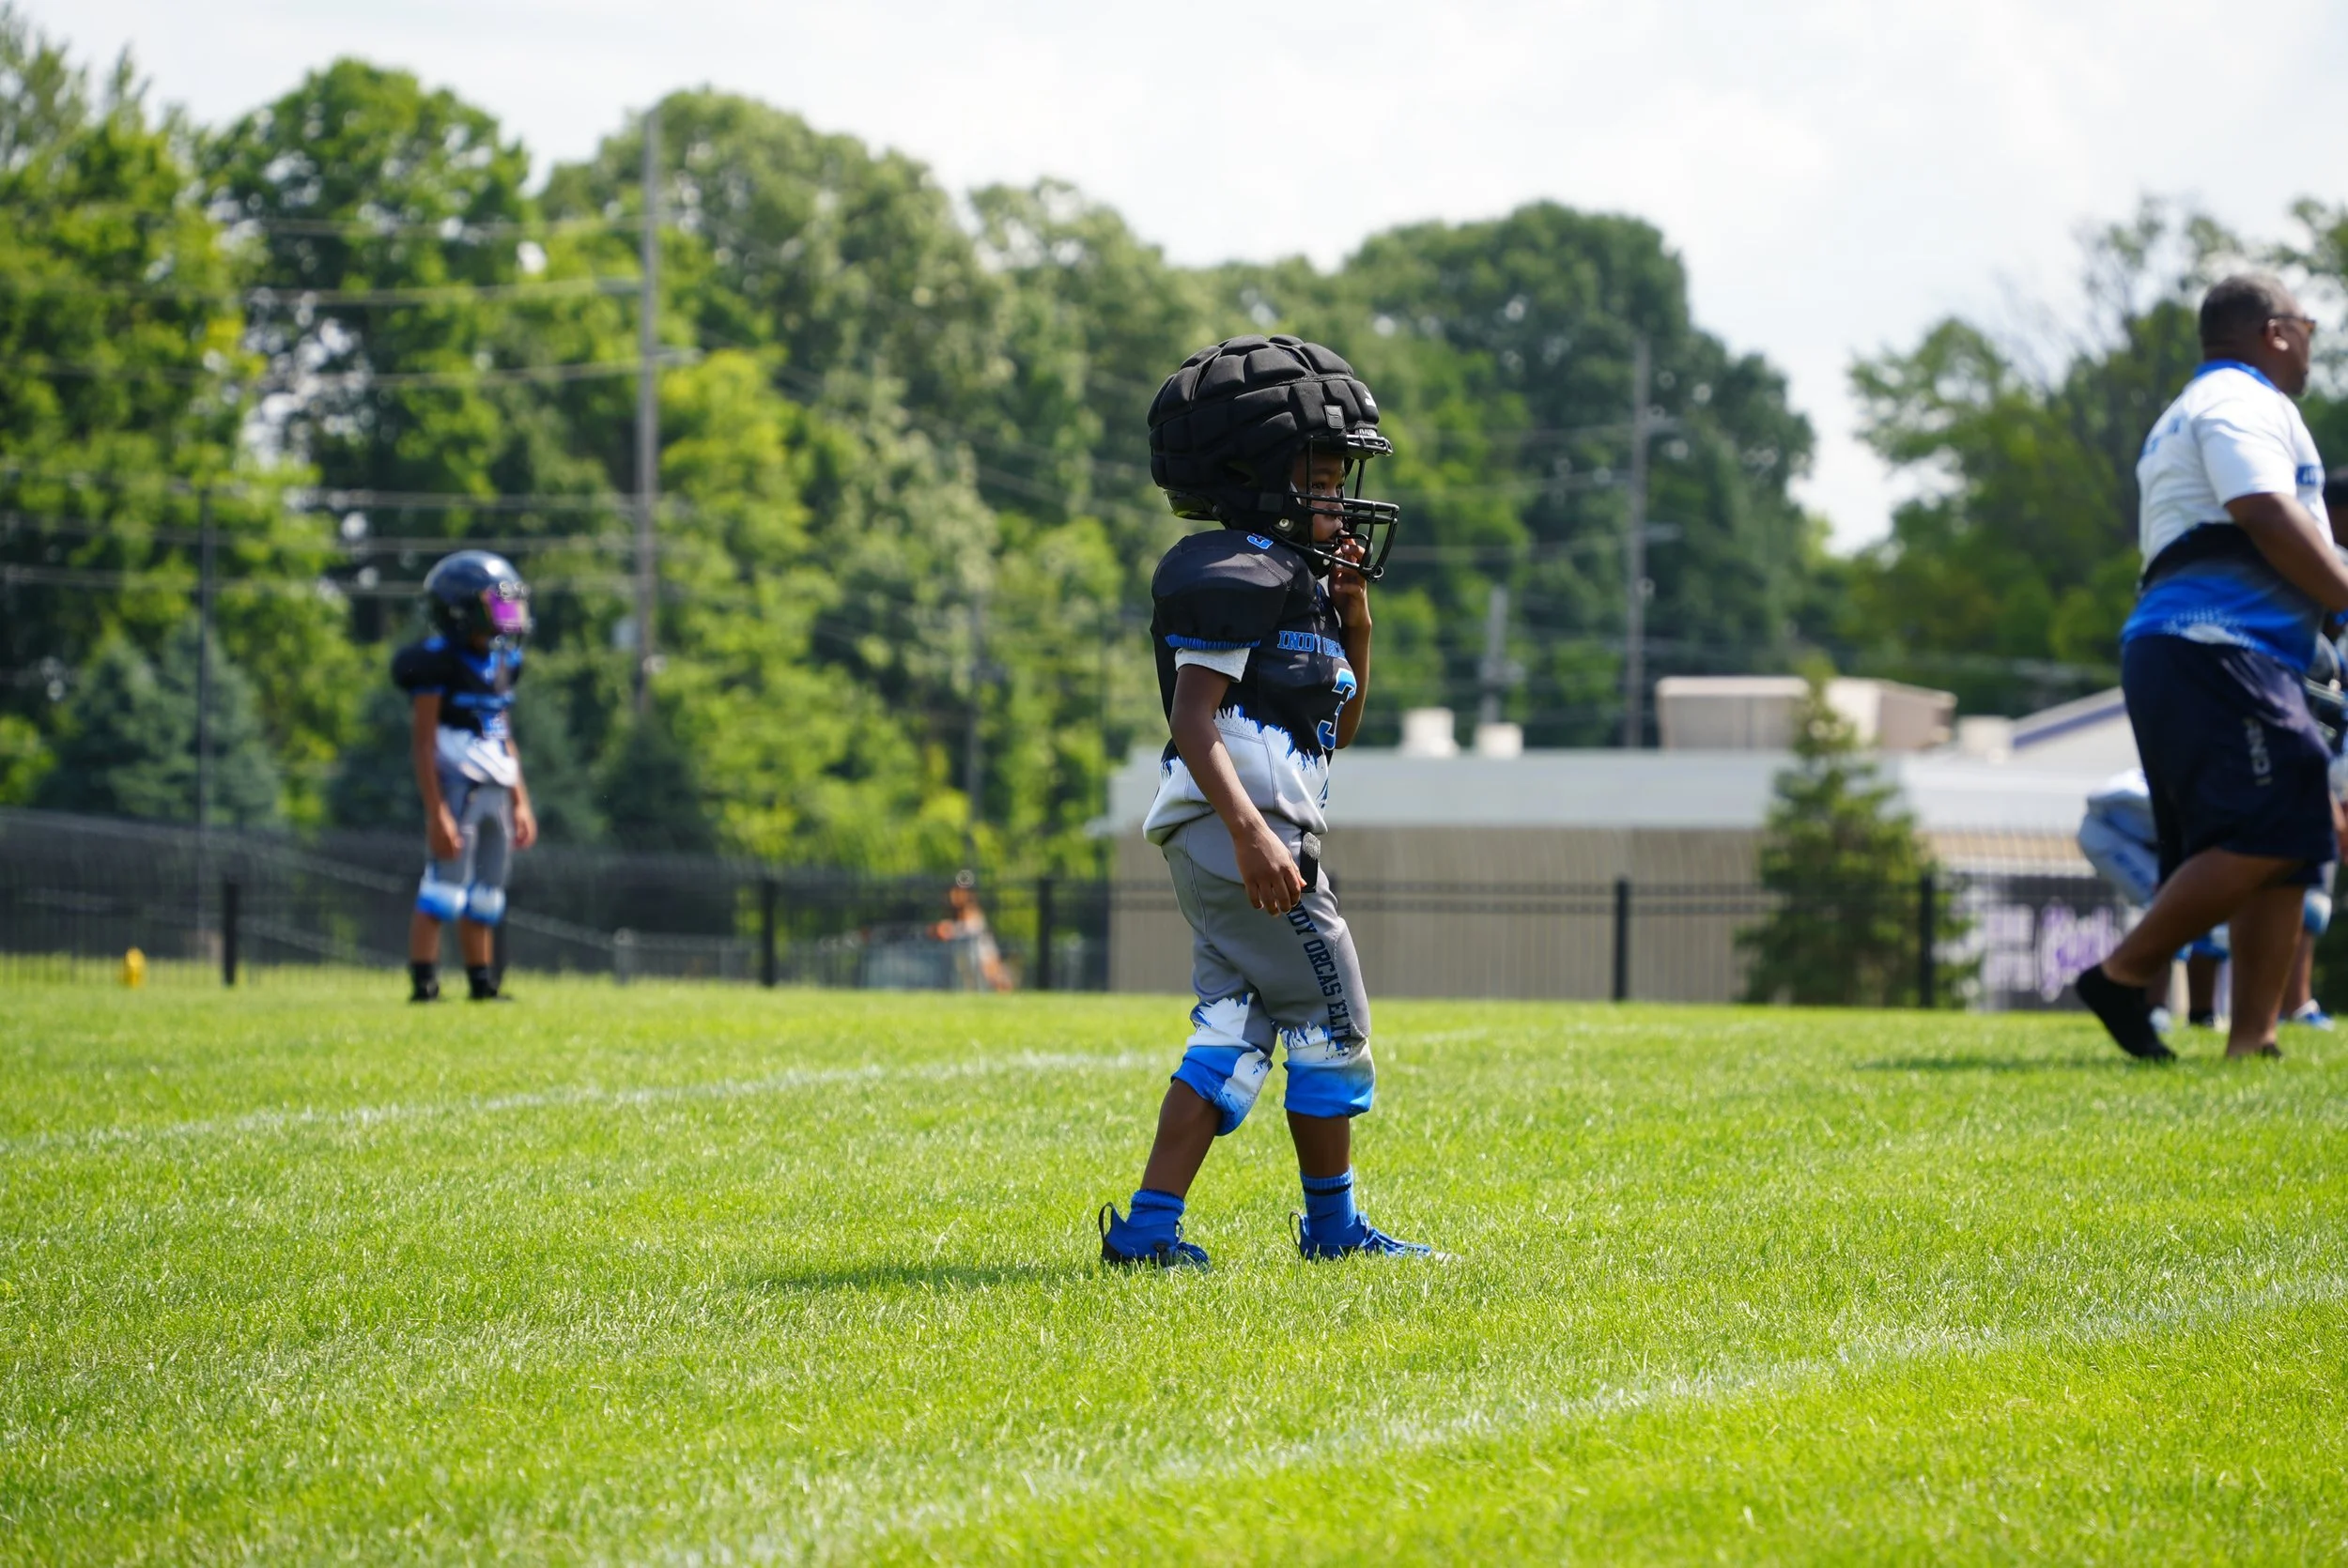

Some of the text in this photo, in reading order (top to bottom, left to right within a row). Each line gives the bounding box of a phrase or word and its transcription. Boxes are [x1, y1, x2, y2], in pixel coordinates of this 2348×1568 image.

[1277, 630, 1321, 653] INDY
[1316, 668, 1357, 750] 3
[1303, 938, 1343, 997] ORCAS
[1326, 998, 1352, 1041] ELIT
